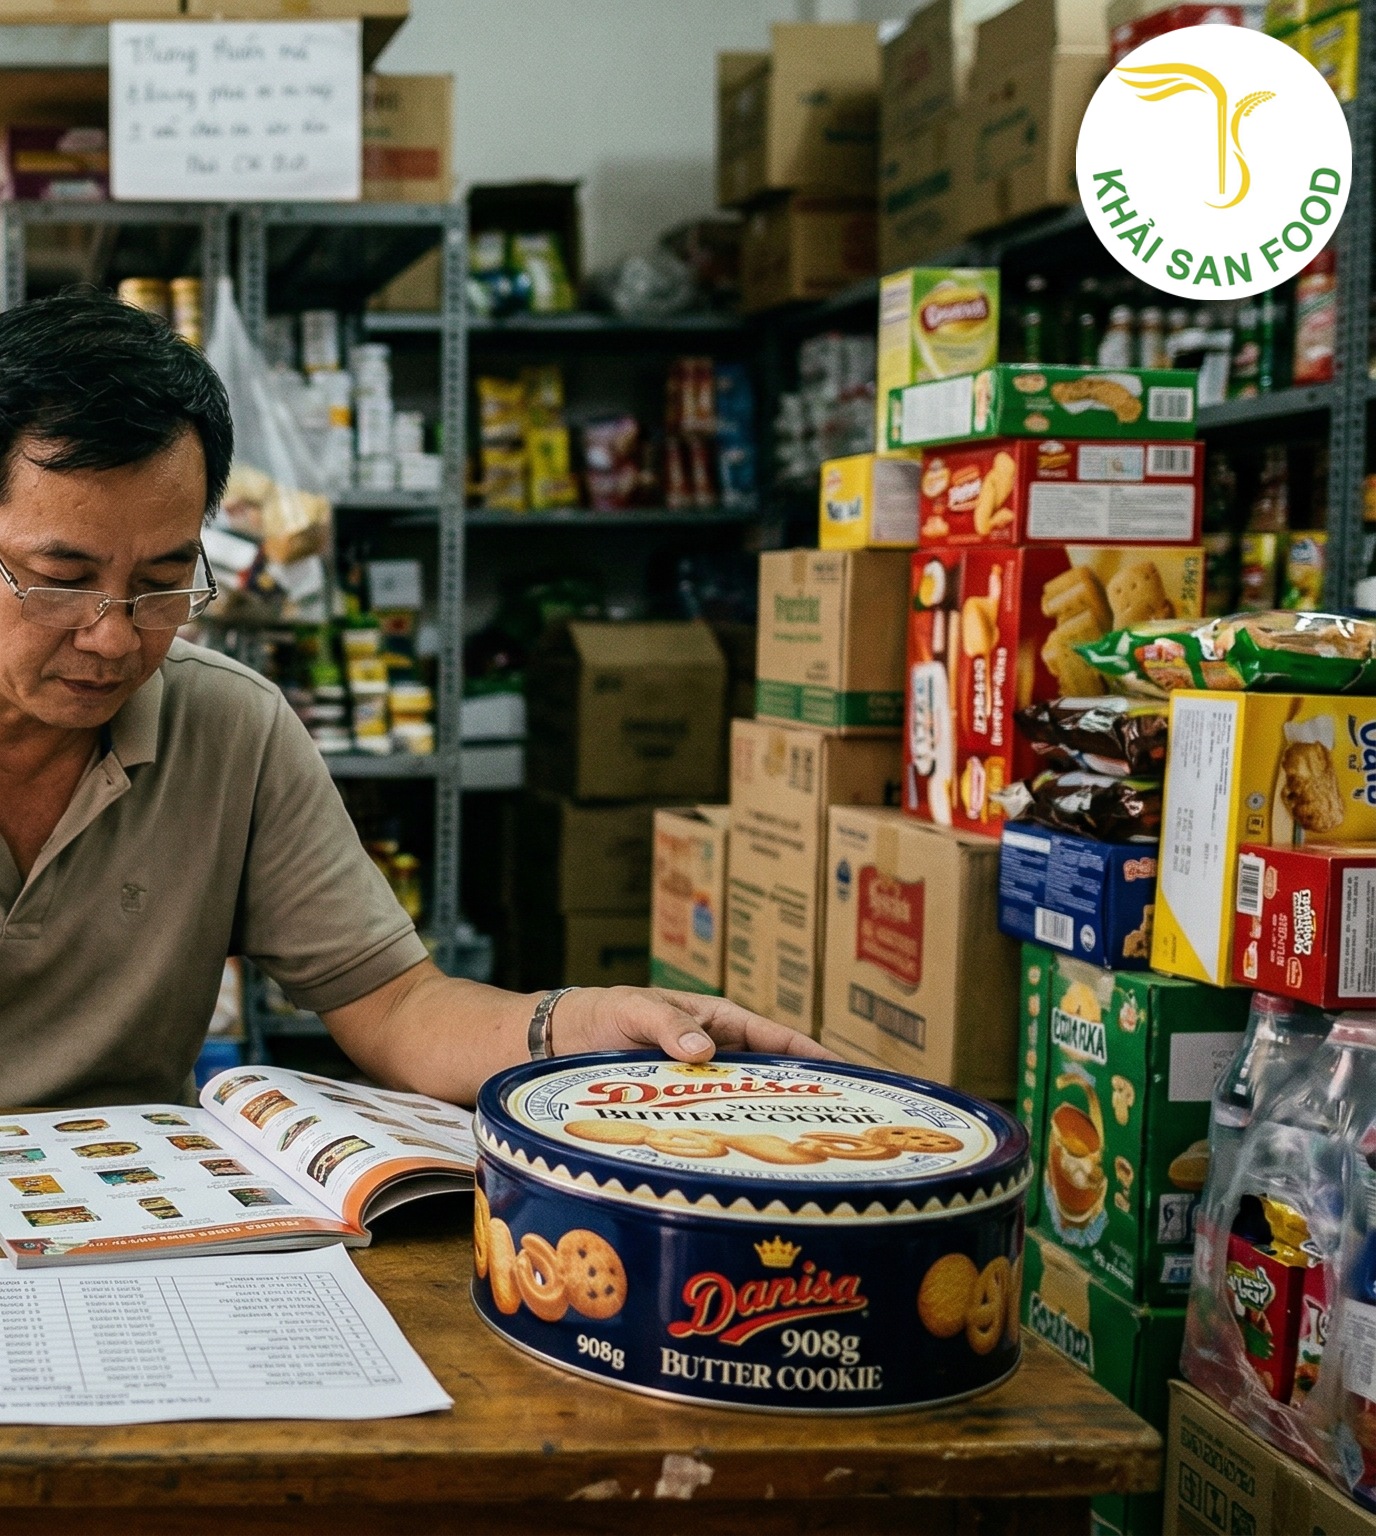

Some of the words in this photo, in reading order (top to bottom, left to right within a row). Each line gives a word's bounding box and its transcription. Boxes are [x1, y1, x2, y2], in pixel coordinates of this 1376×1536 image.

[575, 1077, 843, 1109] Danisa
[594, 1107, 741, 1123] BUTTER
[745, 1112, 893, 1125] COOKIE
[666, 1260, 869, 1347] Danisa
[576, 1332, 626, 1370] 908g
[781, 1329, 862, 1365] 908g
[660, 1346, 773, 1390] BUTTER
[776, 1365, 883, 1393] COOKIE
